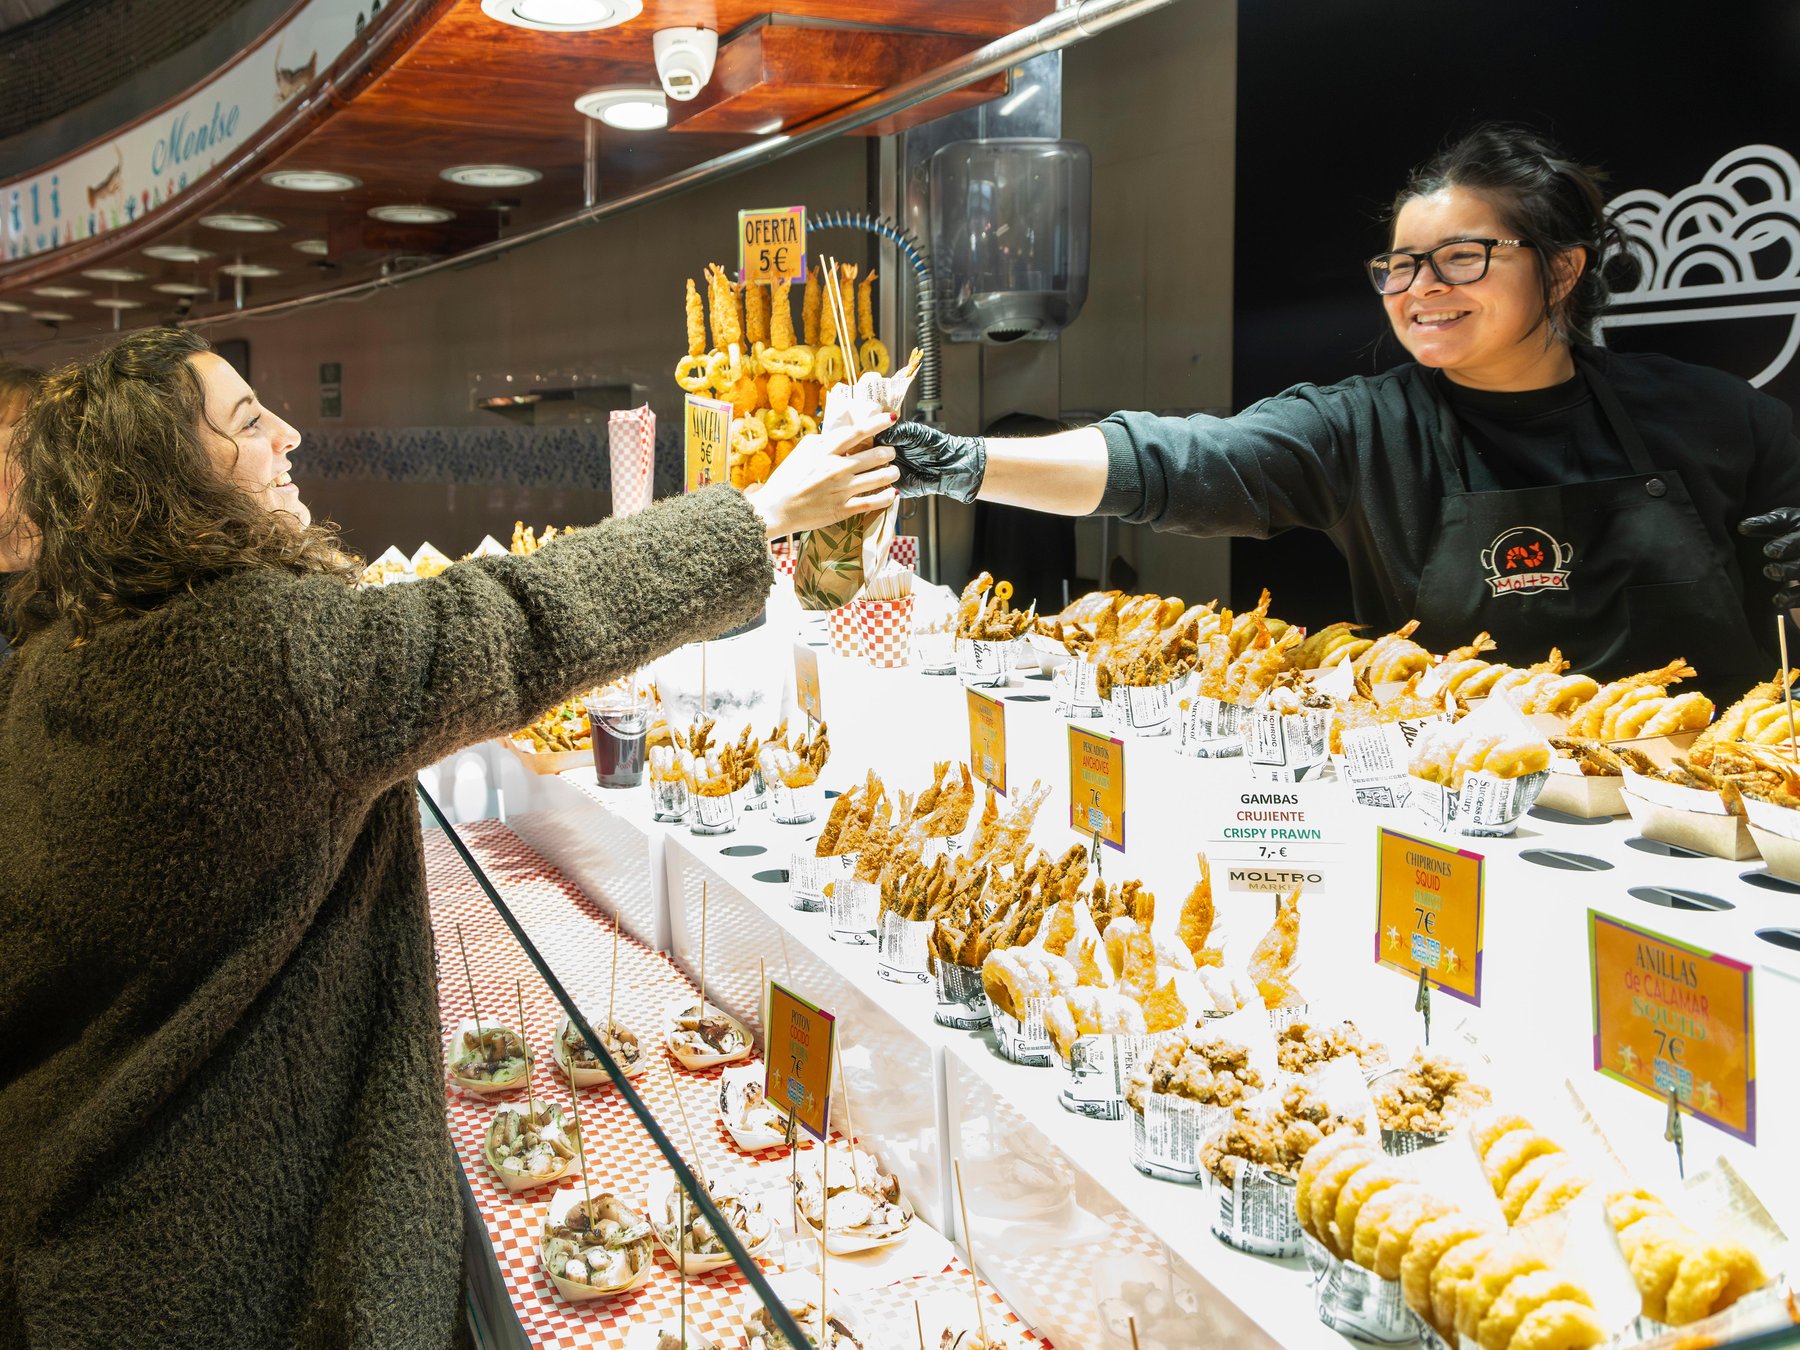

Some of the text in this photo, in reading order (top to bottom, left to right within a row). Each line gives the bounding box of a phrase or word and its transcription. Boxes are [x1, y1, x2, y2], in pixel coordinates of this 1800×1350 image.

[152, 101, 240, 175] Montse
[745, 217, 797, 244] OFERTA
[760, 247, 788, 273] 5€
[700, 441, 713, 465] 5€
[1083, 755, 1109, 774] ANCHOVIES
[1090, 788, 1102, 808] 7€
[1240, 794, 1299, 805] GAMBAS
[1462, 777, 1478, 815] Century
[1473, 779, 1490, 826] Success of
[1236, 811, 1305, 822] CRUJIENTE
[1223, 828, 1321, 839] CRISPY PRAWN
[1259, 847, 1287, 858] 7,- €
[1406, 851, 1451, 877] CHIPIRONES
[1230, 872, 1322, 883] MOLTBO
[1248, 883, 1296, 891] MARKE
[1416, 869, 1440, 891] SQUID
[1415, 907, 1436, 935] 7€
[1412, 933, 1441, 954] MOLTBO
[1411, 948, 1440, 970] MARKET
[1636, 944, 1697, 988] ANILLAS
[1625, 968, 1709, 1019] de CALAMAR
[1633, 997, 1706, 1041] SQUID
[790, 1026, 810, 1047] COCIDO
[1653, 1029, 1685, 1064] 7€
[791, 1055, 804, 1079] 7€
[1654, 1057, 1694, 1086] MOLTBO
[1654, 1073, 1693, 1104] MARET
